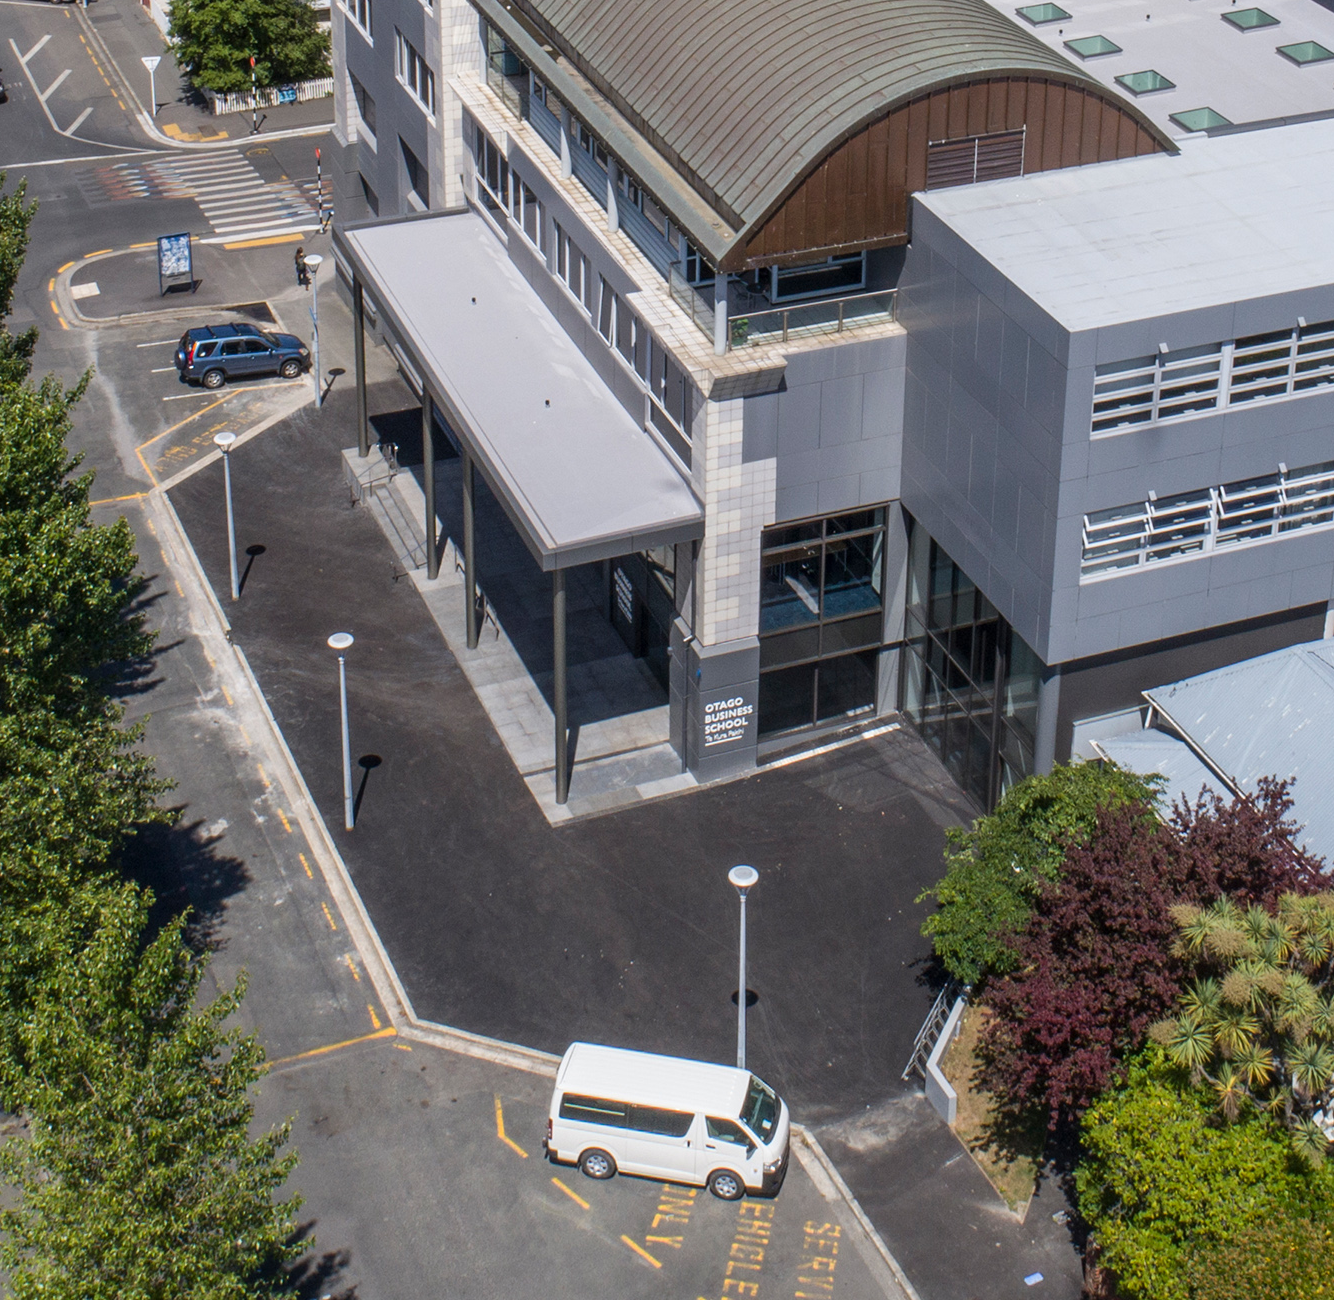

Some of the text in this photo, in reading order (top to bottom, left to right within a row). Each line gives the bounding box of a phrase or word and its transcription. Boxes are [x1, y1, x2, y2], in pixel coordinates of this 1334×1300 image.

[705, 696, 744, 713] OTAGO
[705, 704, 753, 724] BUSINESS
[705, 717, 748, 735] SCHOOL
